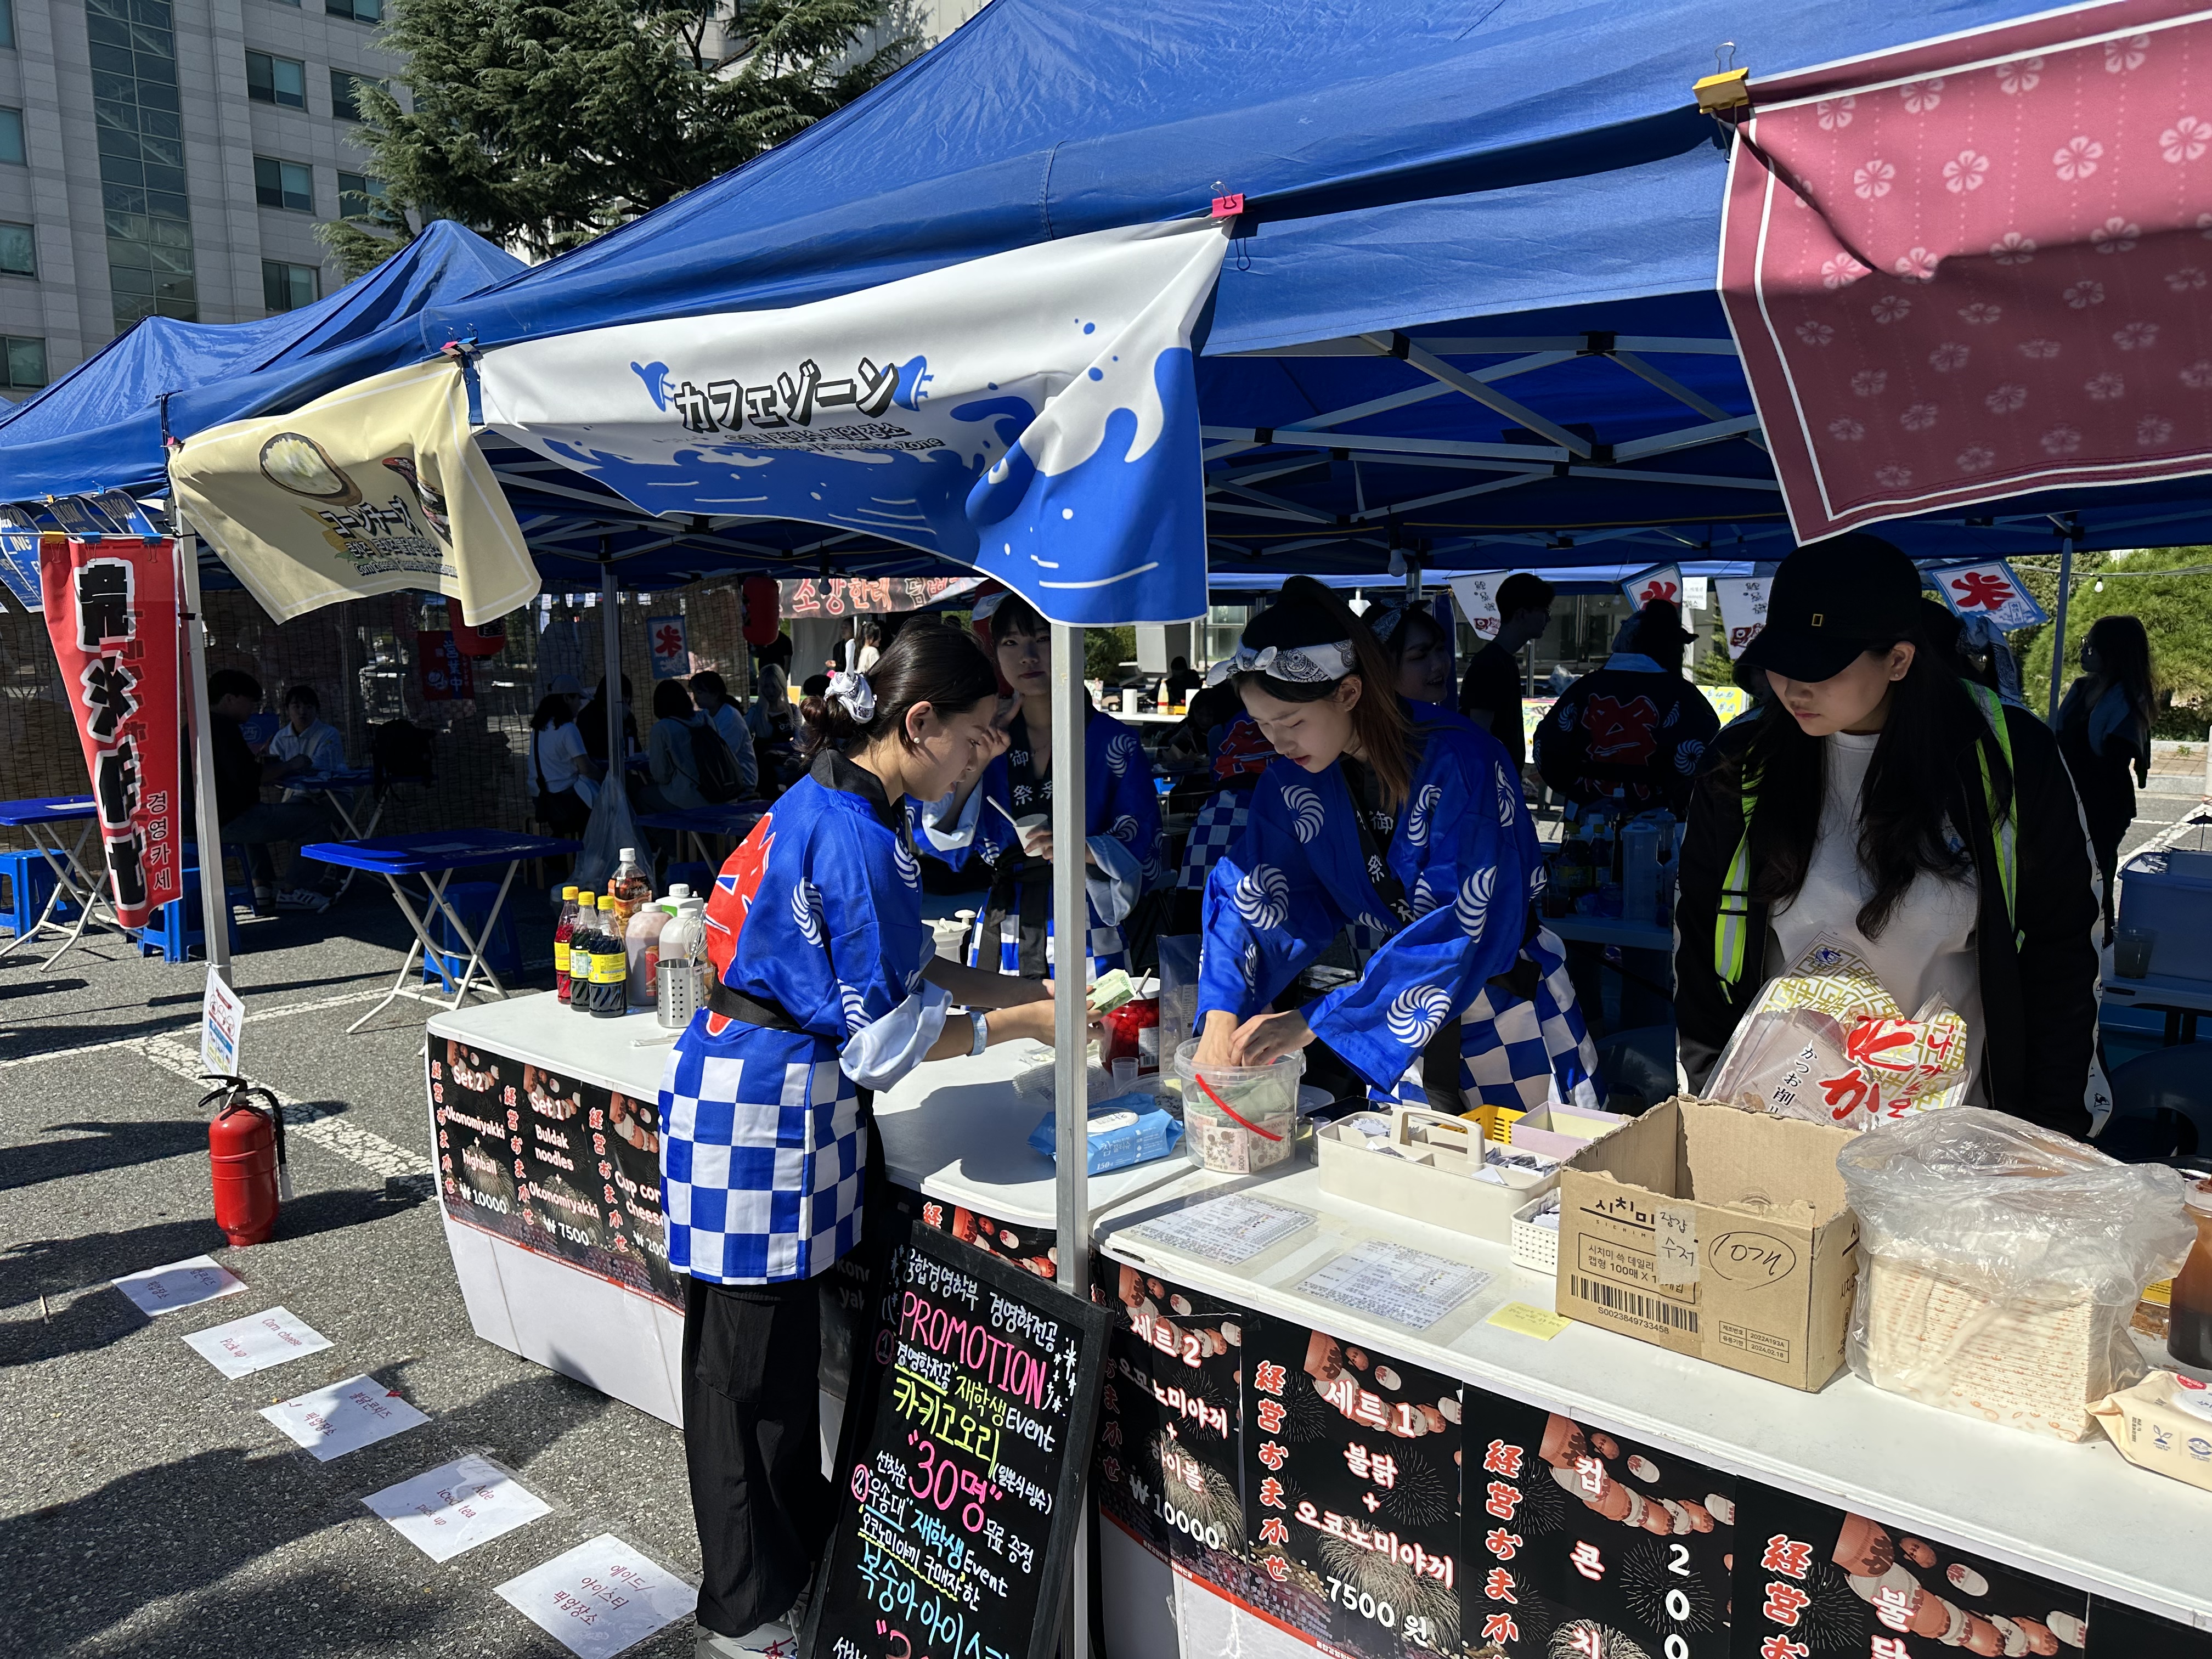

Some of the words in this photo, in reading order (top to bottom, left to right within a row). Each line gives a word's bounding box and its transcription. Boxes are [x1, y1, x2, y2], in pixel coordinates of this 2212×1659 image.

[674, 358, 898, 433] カフェゾーン
[859, 421, 911, 439] 장소
[897, 437, 946, 451] Zone
[318, 495, 424, 539] コーンチーズ
[147, 790, 172, 891] 경영카세
[453, 1064, 474, 1090] Set
[475, 1071, 485, 1093] 2
[445, 1104, 506, 1140] Okonomiyakki
[531, 1091, 553, 1117] Set
[555, 1099, 565, 1121] 1
[431, 1059, 455, 1195] 経営おまかせ
[535, 1124, 569, 1150] Buldak
[461, 1147, 498, 1176] highball
[504, 1085, 535, 1226] 経営おまかせ
[535, 1147, 574, 1171] noodles
[589, 1107, 629, 1253] 経営おまかせ
[614, 1170, 637, 1199] Cup
[472, 1189, 507, 1215] 10000
[528, 1181, 600, 1219] Okonomiyakki
[1595, 1196, 1655, 1225] 시치미
[558, 1222, 590, 1246] 7500
[1660, 1211, 1688, 1234] 장갑
[1588, 1244, 1614, 1260] 시치미
[1616, 1252, 1626, 1264] 쓱
[1627, 1256, 1654, 1272] 데일리
[1588, 1255, 1606, 1269] 캡형
[1610, 1262, 1638, 1279] 100매
[1641, 1271, 1649, 1282] X
[1661, 1236, 1695, 1267] 수저
[262, 1318, 281, 1331] Corn
[278, 1331, 303, 1346] cheese
[989, 1291, 1058, 1353] 경영학전공
[1597, 1306, 1671, 1335] S0023849733458
[1722, 1324, 1744, 1335] 제조번호
[1750, 1333, 1785, 1348] 2022A193A
[219, 1338, 240, 1351] Pick
[899, 1291, 1047, 1410] PROMOTION
[1130, 1313, 1178, 1358] 세트
[1182, 1334, 1203, 1368] 2
[1751, 1344, 1784, 1358] 2024.02.18
[348, 1391, 393, 1419] 불닭콘치즈
[954, 1375, 1007, 1427] 재학생
[1005, 1406, 1056, 1453] Event
[1322, 1379, 1388, 1428] 세트
[1396, 1401, 1416, 1439] 1
[304, 1412, 337, 1436] 픽업장소
[893, 1375, 1000, 1479] 카키고오리
[1150, 1440, 1205, 1492] 하이볼
[1254, 1359, 1290, 1582] 経営おまかせ
[1344, 1442, 1398, 1489] 불닭
[436, 1487, 464, 1506] iced
[458, 1504, 477, 1519] tea
[471, 1485, 494, 1500] Ade
[414, 1504, 438, 1517] pick
[433, 1516, 447, 1526] up
[876, 1450, 907, 1490] 선착순
[983, 1519, 1005, 1556] 무료
[1008, 1534, 1034, 1574] 증정
[1153, 1499, 1220, 1550] 10000
[910, 1508, 965, 1570] 재학생
[964, 1552, 1008, 1598] Event
[1294, 1500, 1455, 1590] 오코노미야끼
[1481, 1438, 1524, 1659] 経営おまか
[580, 1577, 630, 1611] 아이스티
[857, 1541, 918, 1621] 복숭아
[553, 1590, 598, 1626] 픽업장소
[1325, 1573, 1396, 1629] 7500
[1403, 1615, 1428, 1647] 원
